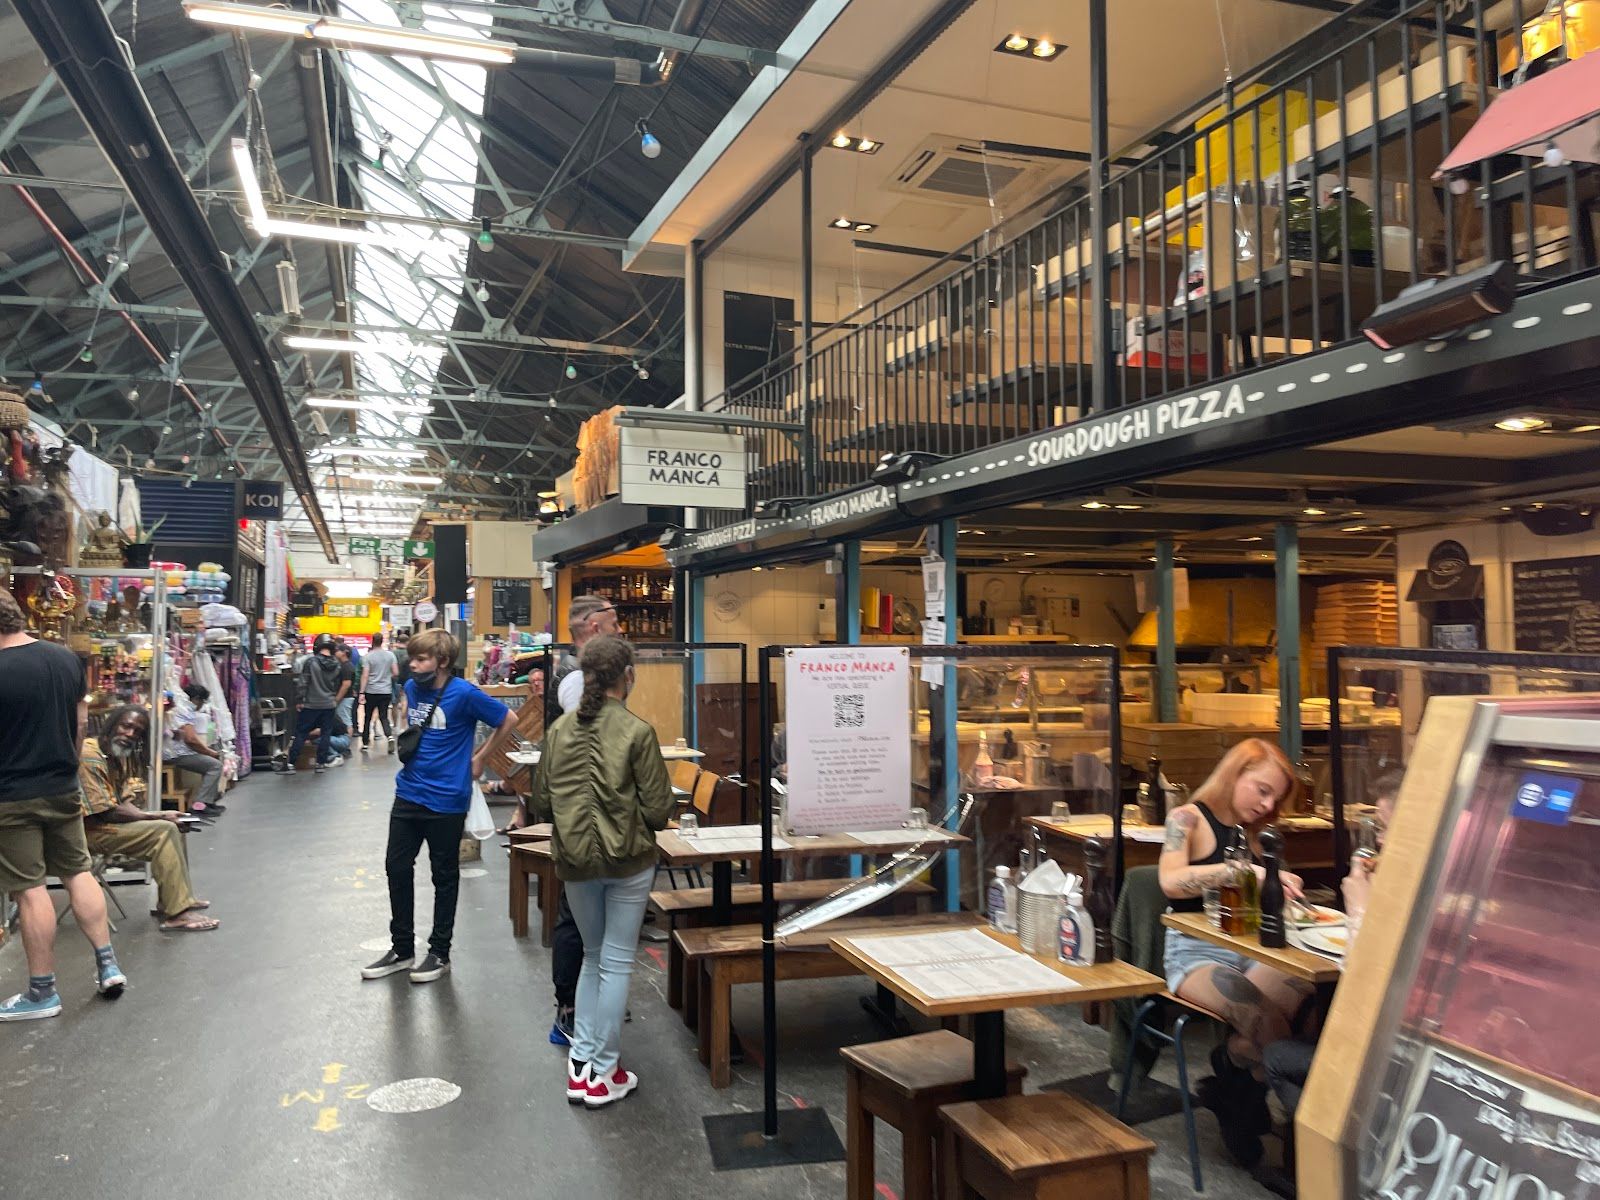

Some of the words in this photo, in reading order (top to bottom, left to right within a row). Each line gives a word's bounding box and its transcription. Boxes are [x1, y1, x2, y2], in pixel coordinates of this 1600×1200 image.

[1027, 409, 1151, 467] SOURDOUGH
[1156, 384, 1245, 435] PIZZA
[647, 450, 722, 469] FRANCO
[649, 468, 720, 487] MANCA
[245, 493, 279, 508] KOI
[810, 500, 849, 526] FRANCO
[849, 486, 891, 515] MANCA
[351, 537, 376, 547] Fire
[799, 662, 848, 674] FRANCO
[851, 661, 896, 674] MANCA
[417, 702, 433, 712] THE
